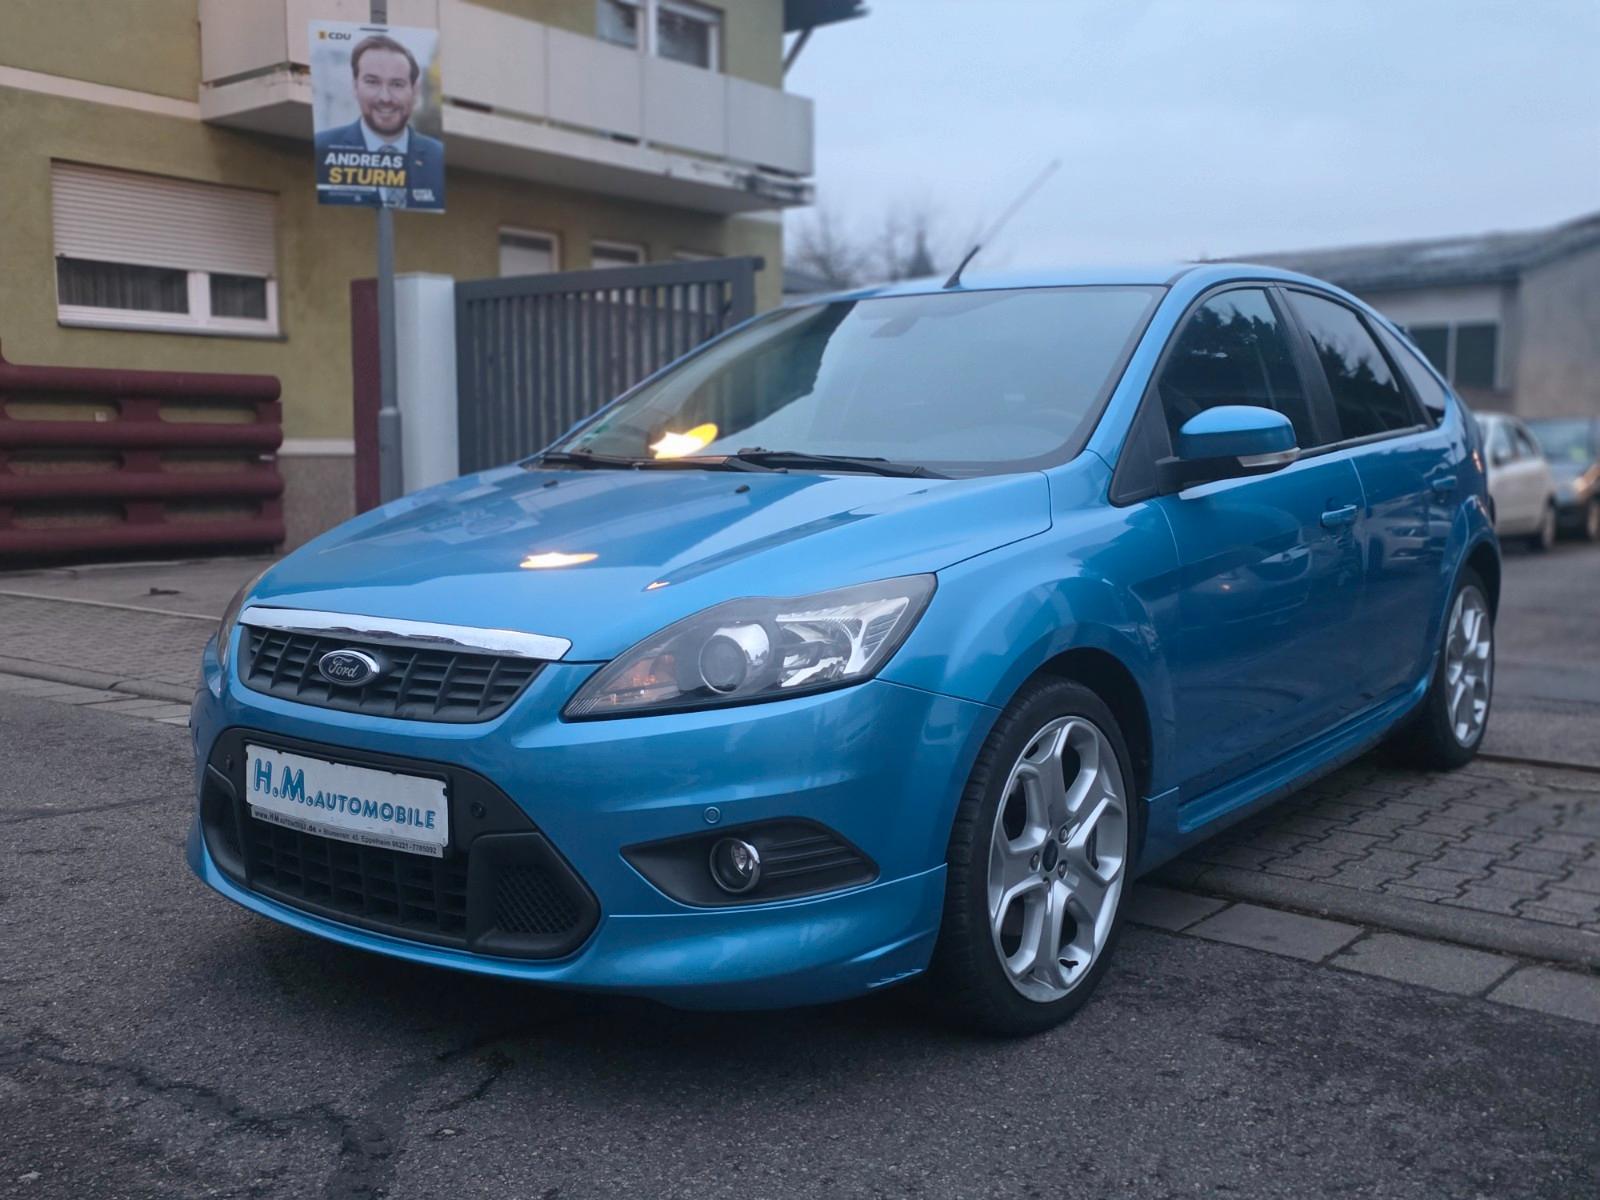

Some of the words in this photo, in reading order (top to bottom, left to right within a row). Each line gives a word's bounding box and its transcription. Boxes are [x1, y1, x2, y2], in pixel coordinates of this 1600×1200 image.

[328, 32, 352, 41] CDU
[324, 152, 404, 169] ANDREAS
[328, 167, 407, 187] STURM
[328, 656, 360, 678] Ford
